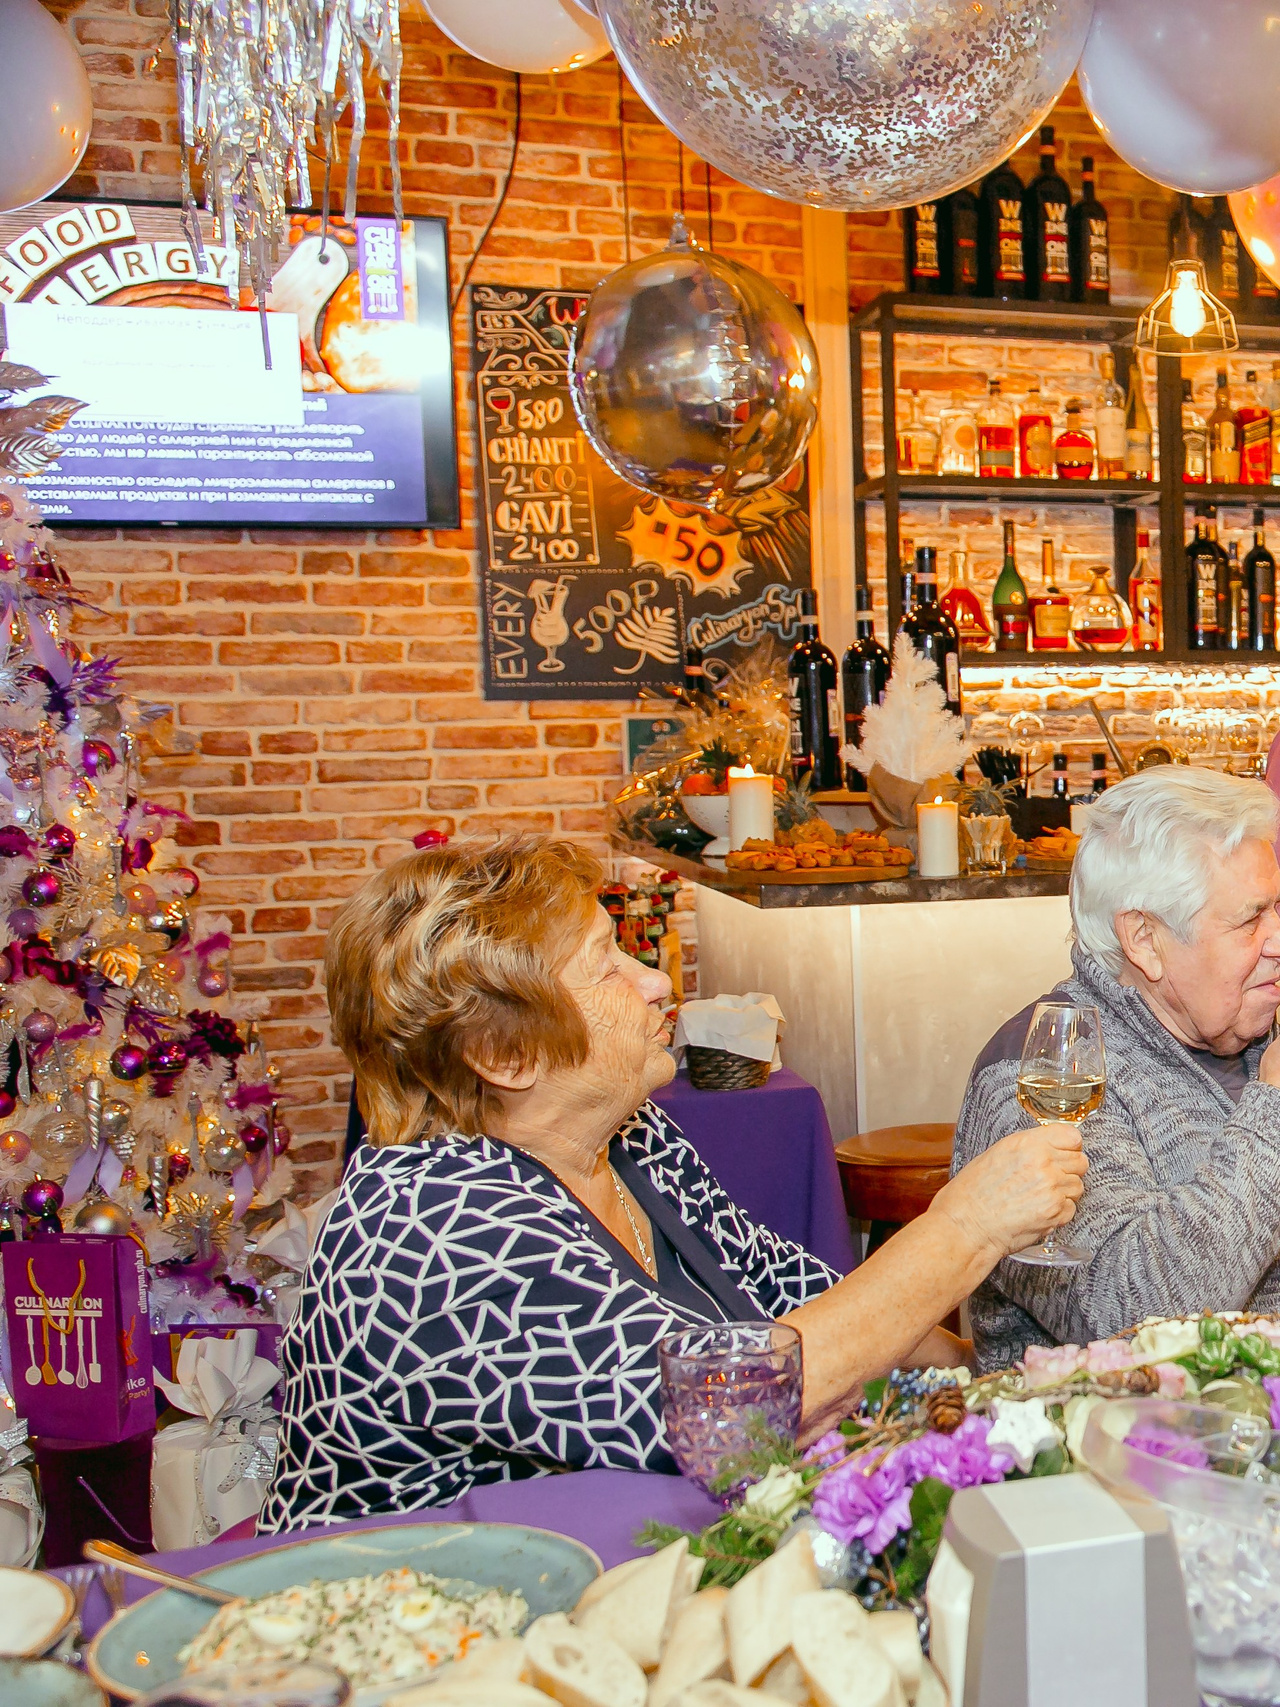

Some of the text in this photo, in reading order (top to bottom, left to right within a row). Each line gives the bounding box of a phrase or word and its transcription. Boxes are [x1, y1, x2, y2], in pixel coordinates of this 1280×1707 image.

[517, 397, 563, 430] 580
[101, 433, 145, 445] людей
[147, 435, 158, 445] с
[501, 464, 576, 496] 2400
[119, 490, 188, 502] продуктах
[189, 491, 200, 501] и
[509, 535, 580, 564] 2400
[491, 580, 528, 680] EVERY
